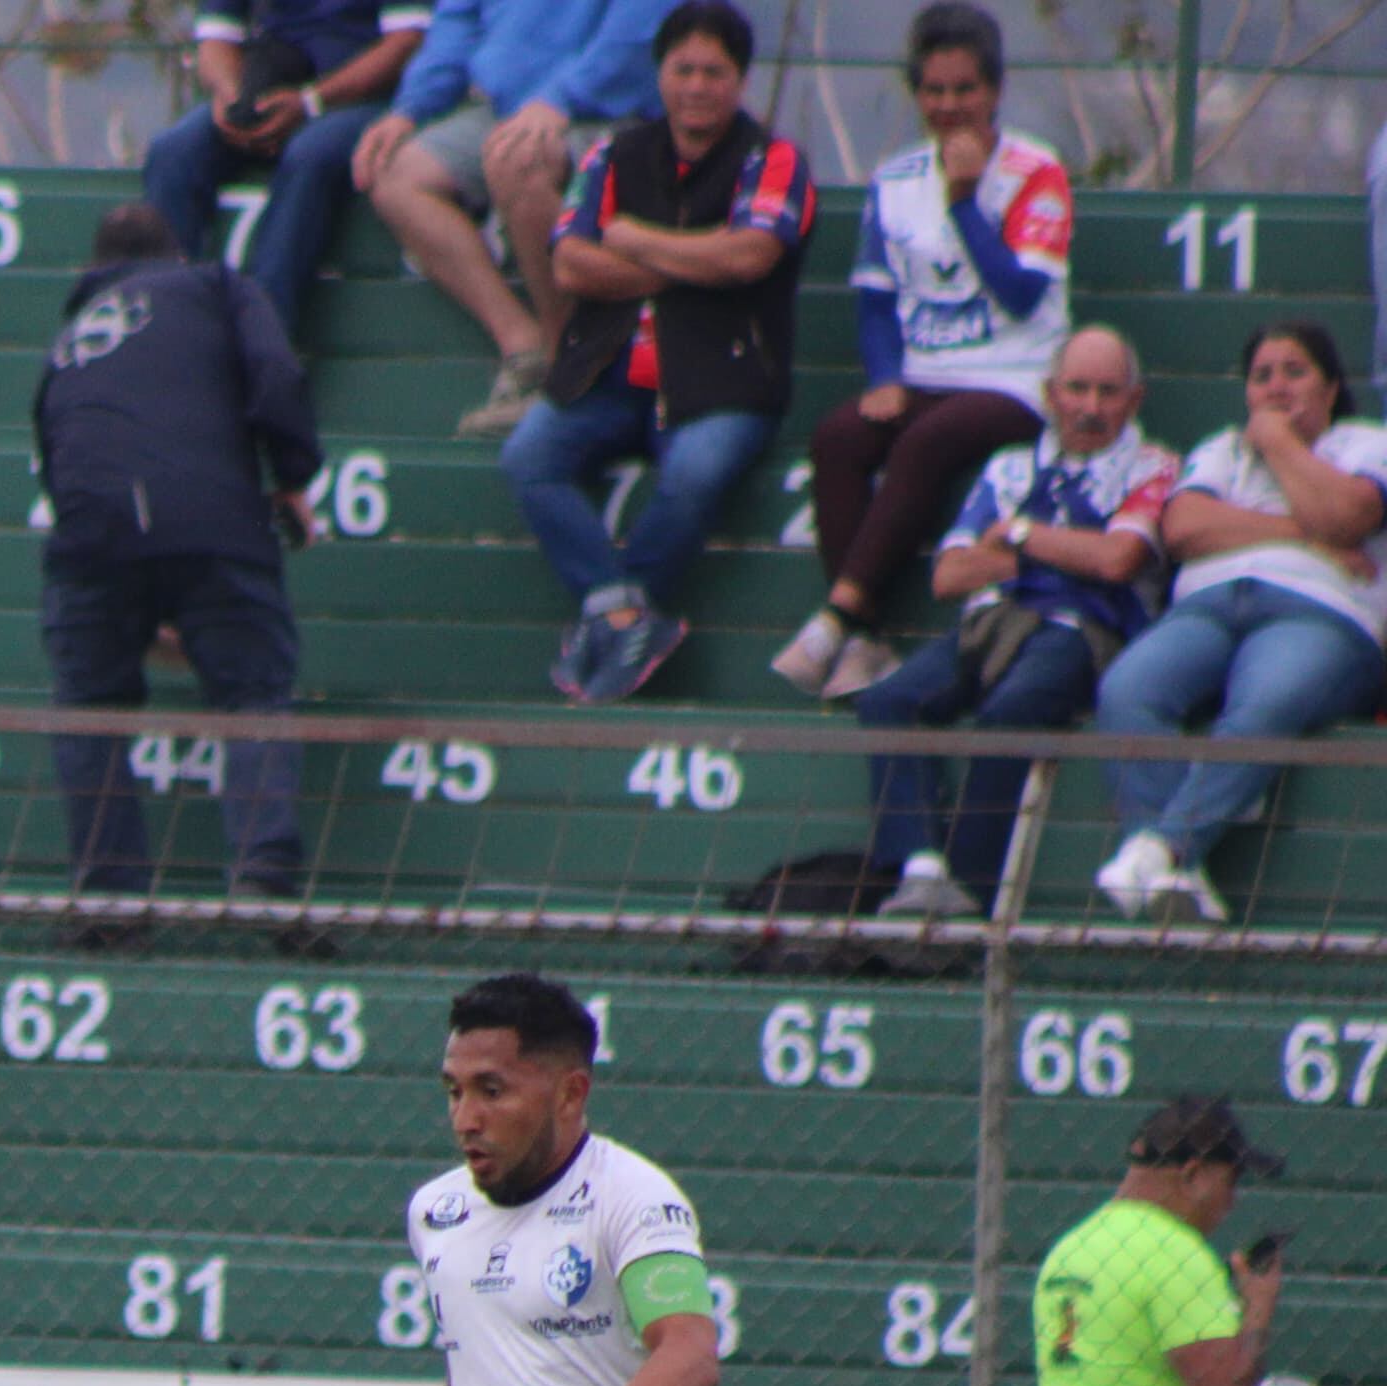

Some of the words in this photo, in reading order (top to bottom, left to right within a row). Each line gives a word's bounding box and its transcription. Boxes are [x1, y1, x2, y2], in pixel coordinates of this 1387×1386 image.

[1163, 205, 1258, 292] 11
[129, 731, 226, 796] 44
[380, 739, 496, 802] 45
[627, 742, 743, 810] 46
[0, 974, 111, 1062] 62
[254, 984, 365, 1071] 63
[760, 1001, 875, 1090] 65
[1019, 1009, 1134, 1097] 66
[1283, 1018, 1387, 1108] 67
[123, 1255, 228, 1341] 81
